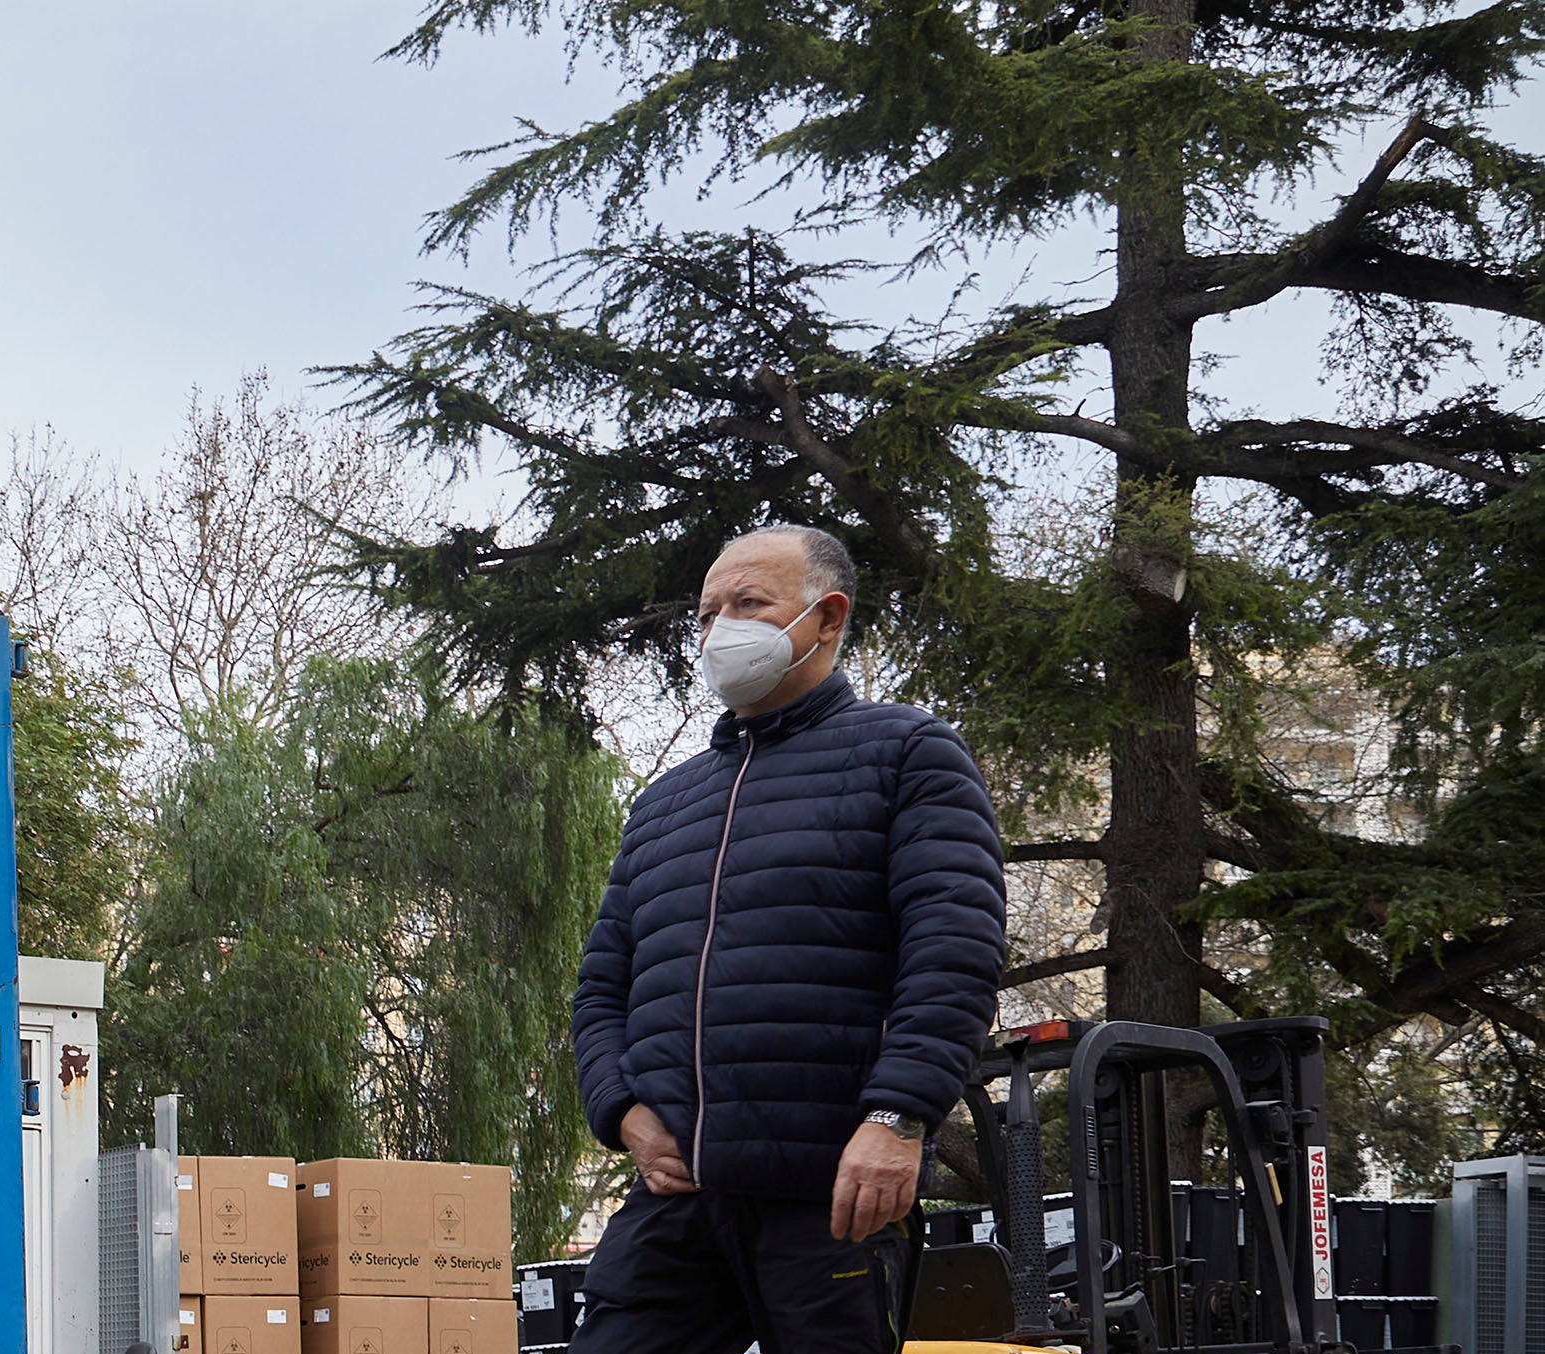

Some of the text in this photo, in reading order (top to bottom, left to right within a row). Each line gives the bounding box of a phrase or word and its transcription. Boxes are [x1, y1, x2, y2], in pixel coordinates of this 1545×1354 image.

[1310, 1151, 1329, 1261] JOFEMESA
[230, 1251, 287, 1268] Stericycle
[365, 1252, 419, 1270] Stericycle
[450, 1255, 501, 1273] Stericycle
